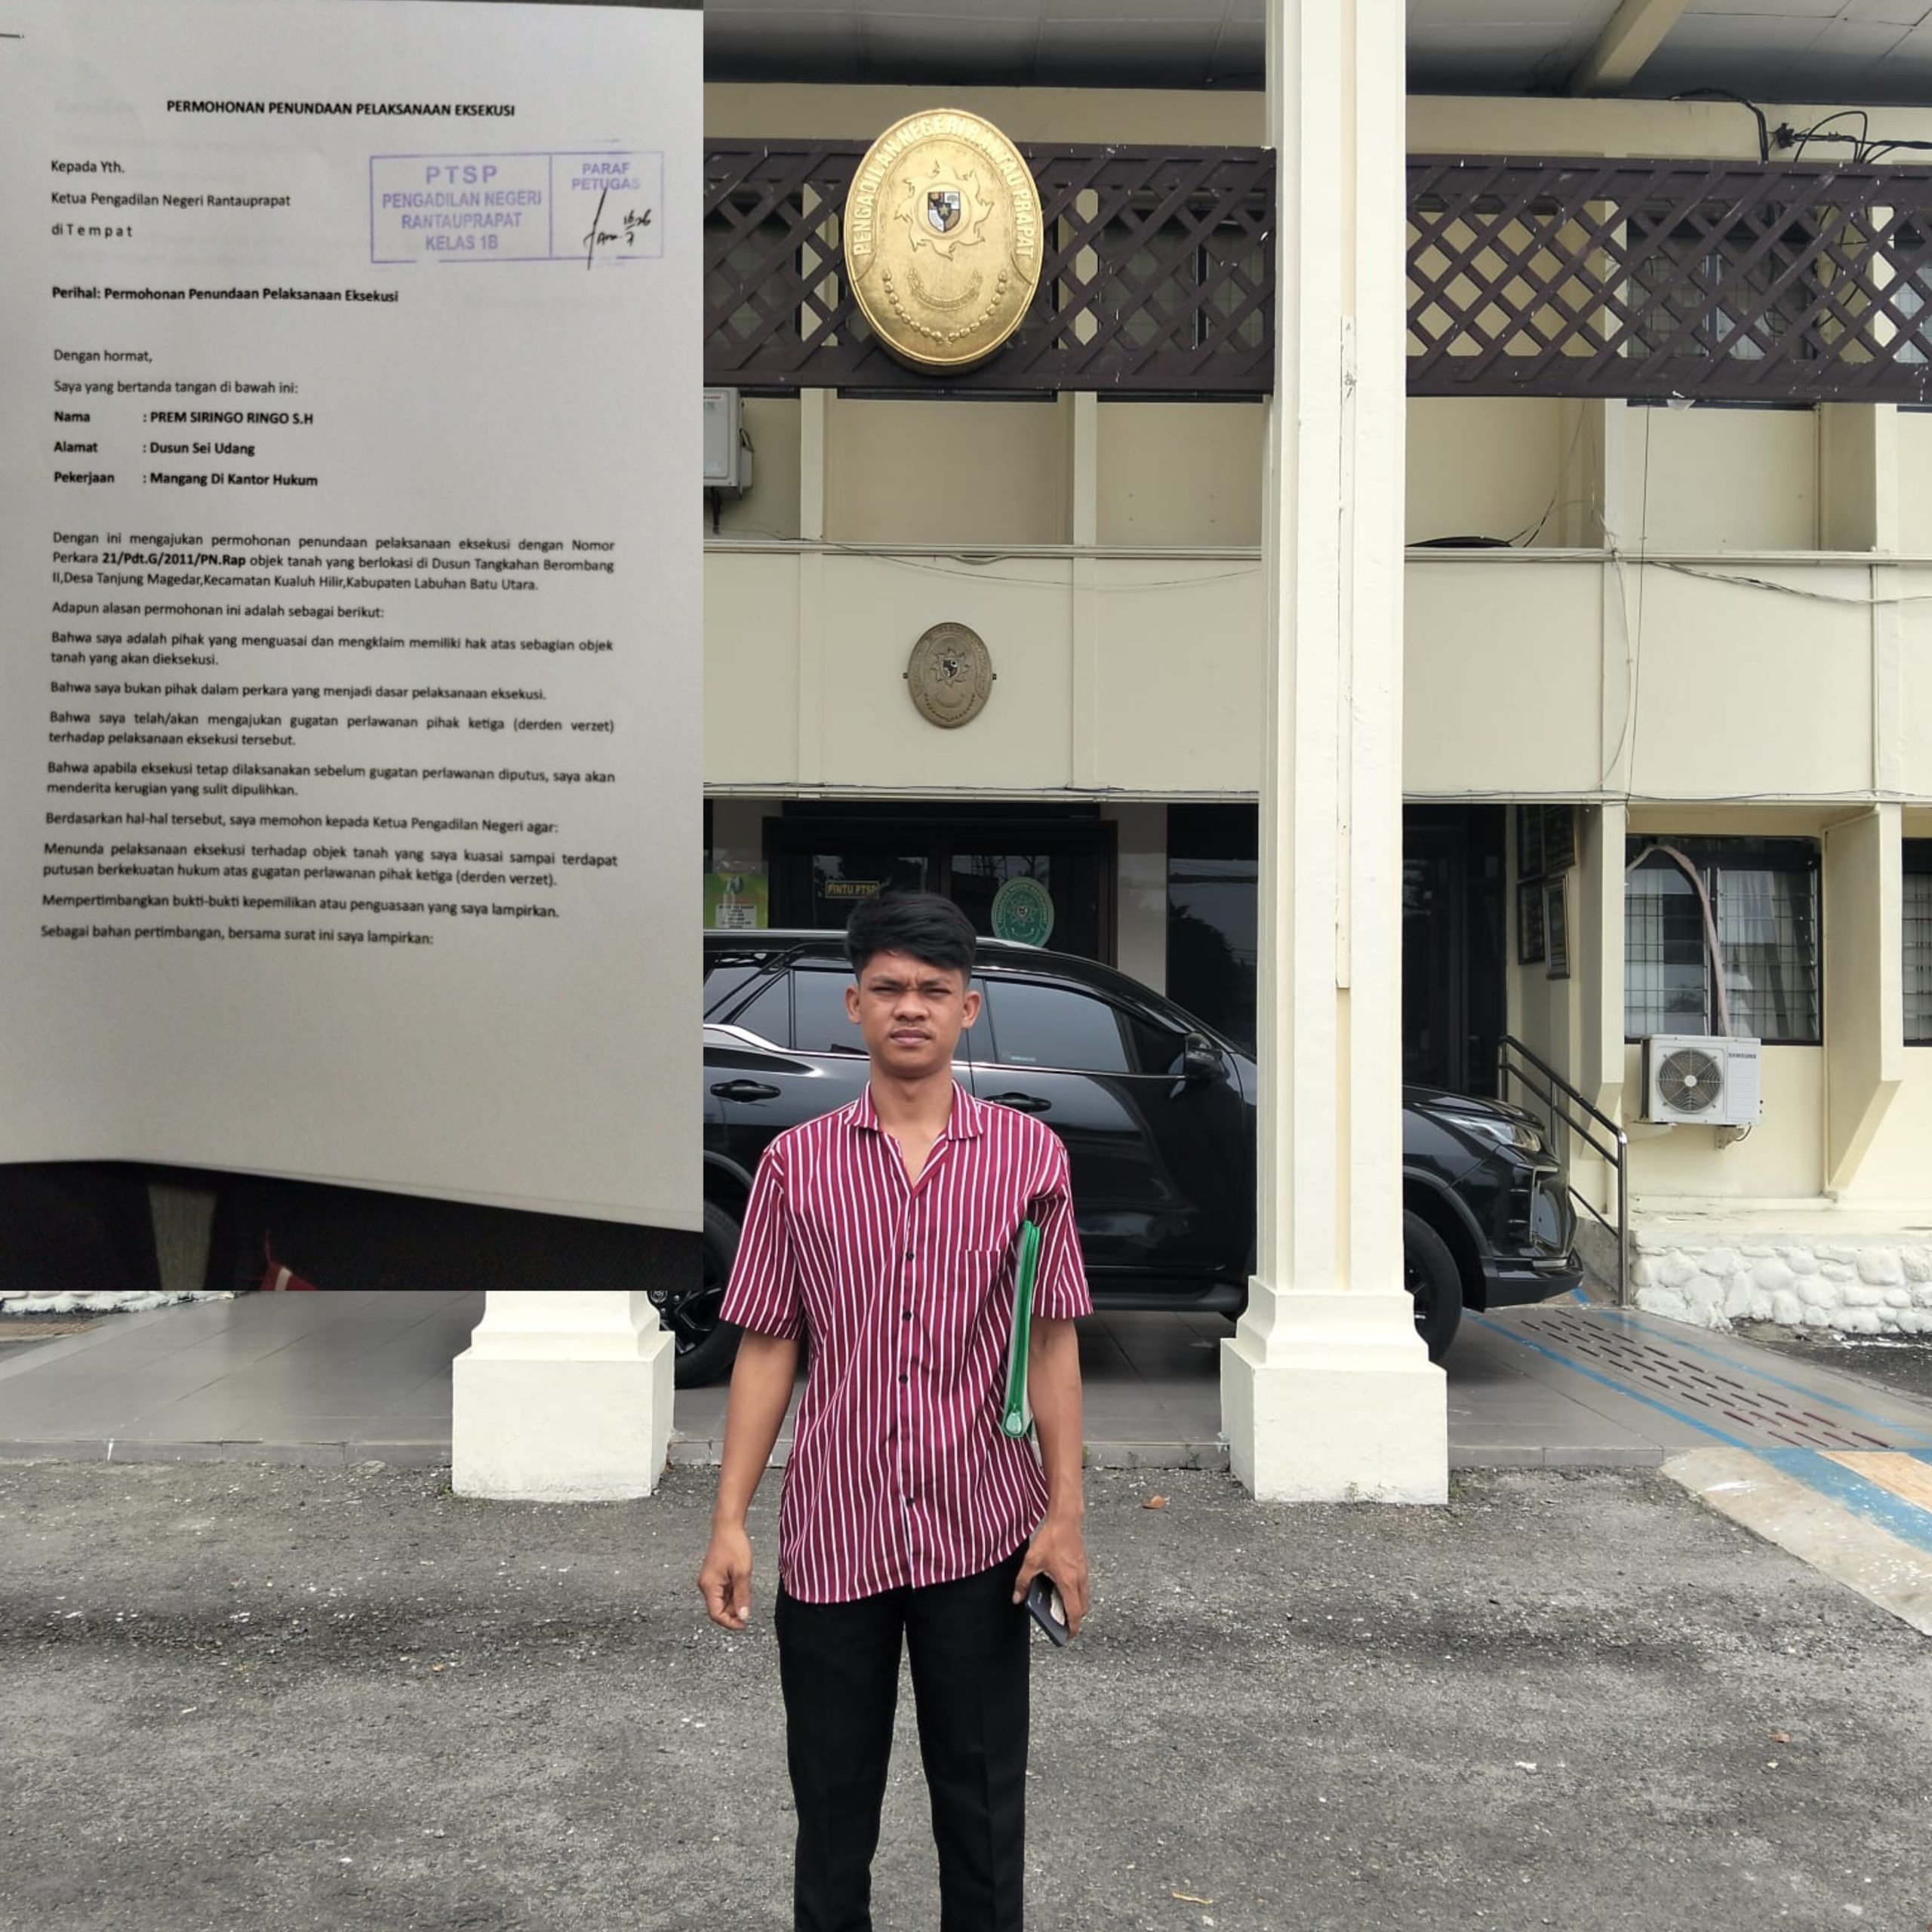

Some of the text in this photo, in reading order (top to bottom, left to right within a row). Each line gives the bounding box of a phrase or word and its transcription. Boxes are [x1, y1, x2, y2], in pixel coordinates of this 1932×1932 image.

[167, 100, 515, 117] PERMOHONAN PENUNDAAN PELAKSANAAN EKSEKUSI
[51, 159, 125, 175] Kepada Yth.
[425, 165, 498, 184] PTSP
[582, 162, 630, 175] PARAF
[571, 177, 641, 190] PETUGAS
[51, 192, 291, 210] Ketua Pengadilan Negeri Rantauprapat
[382, 189, 542, 208] PENGADILAN NEGERI
[853, 141, 900, 256] PENGADILAN
[401, 212, 522, 229] RANTAUPRAPAT
[425, 234, 499, 251] KELAS 1B
[51, 285, 399, 303] Perihal: Permohonan Penundaan Pelaksanaan Eksekusi
[54, 349, 152, 365] Dengan hormat,
[54, 380, 298, 395] Saya yang bertanda tangan di bawah ini:
[54, 411, 314, 425] Nama PREM SIRINGO RINGO S.H
[53, 440, 256, 457] Alamat Dusun Sei Udang
[54, 470, 318, 488] Pekerjaan Mangang Di Kantor Hukum
[53, 531, 615, 554] Dengan ini mengajukan permohonan penundaan pelaksanaan eksekusi dengan Nomor
[52, 551, 614, 574] Perkara 21/Pdt.G/2011/PN.Rap objek tanah yang berlokasi di Dusun Tangkahan Berombang
[52, 571, 538, 591] II,Desa Tanjung Magedar,Kecamatan Kualuh Hilir,Kabupaten Labuhan Batu Utara.
[51, 601, 384, 620] Adapun alasan permohonan ini adalah sebagai berikut:
[51, 631, 614, 654] Bahwa saya adalah pihak yang menguasai dan mengklaim memiliki hak atas sebagian objek
[50, 651, 219, 667] tanah yang akan dieksekusi.
[49, 710, 614, 734] Bahwa saya telah/akan mengajukan gugatan perlawanan pihak ketiga (derden verzet)
[48, 731, 296, 746] terhadap pelaksanaan eksekusi tersebut.
[46, 781, 298, 798] menderita kerugian yang sulit dipulihkan.
[45, 811, 558, 836] Berdasarkan hal-hal tersebut, saya memohon kepada Ketua Pengadilan Negeri agar:
[42, 863, 557, 888] putusan berkekuatan hukum atas gugatan perlawanan pihak ketiga (derden verzet).
[40, 924, 434, 946] Sebagai bahan pertimbangan, bersama surat ini saya lampirkan:
